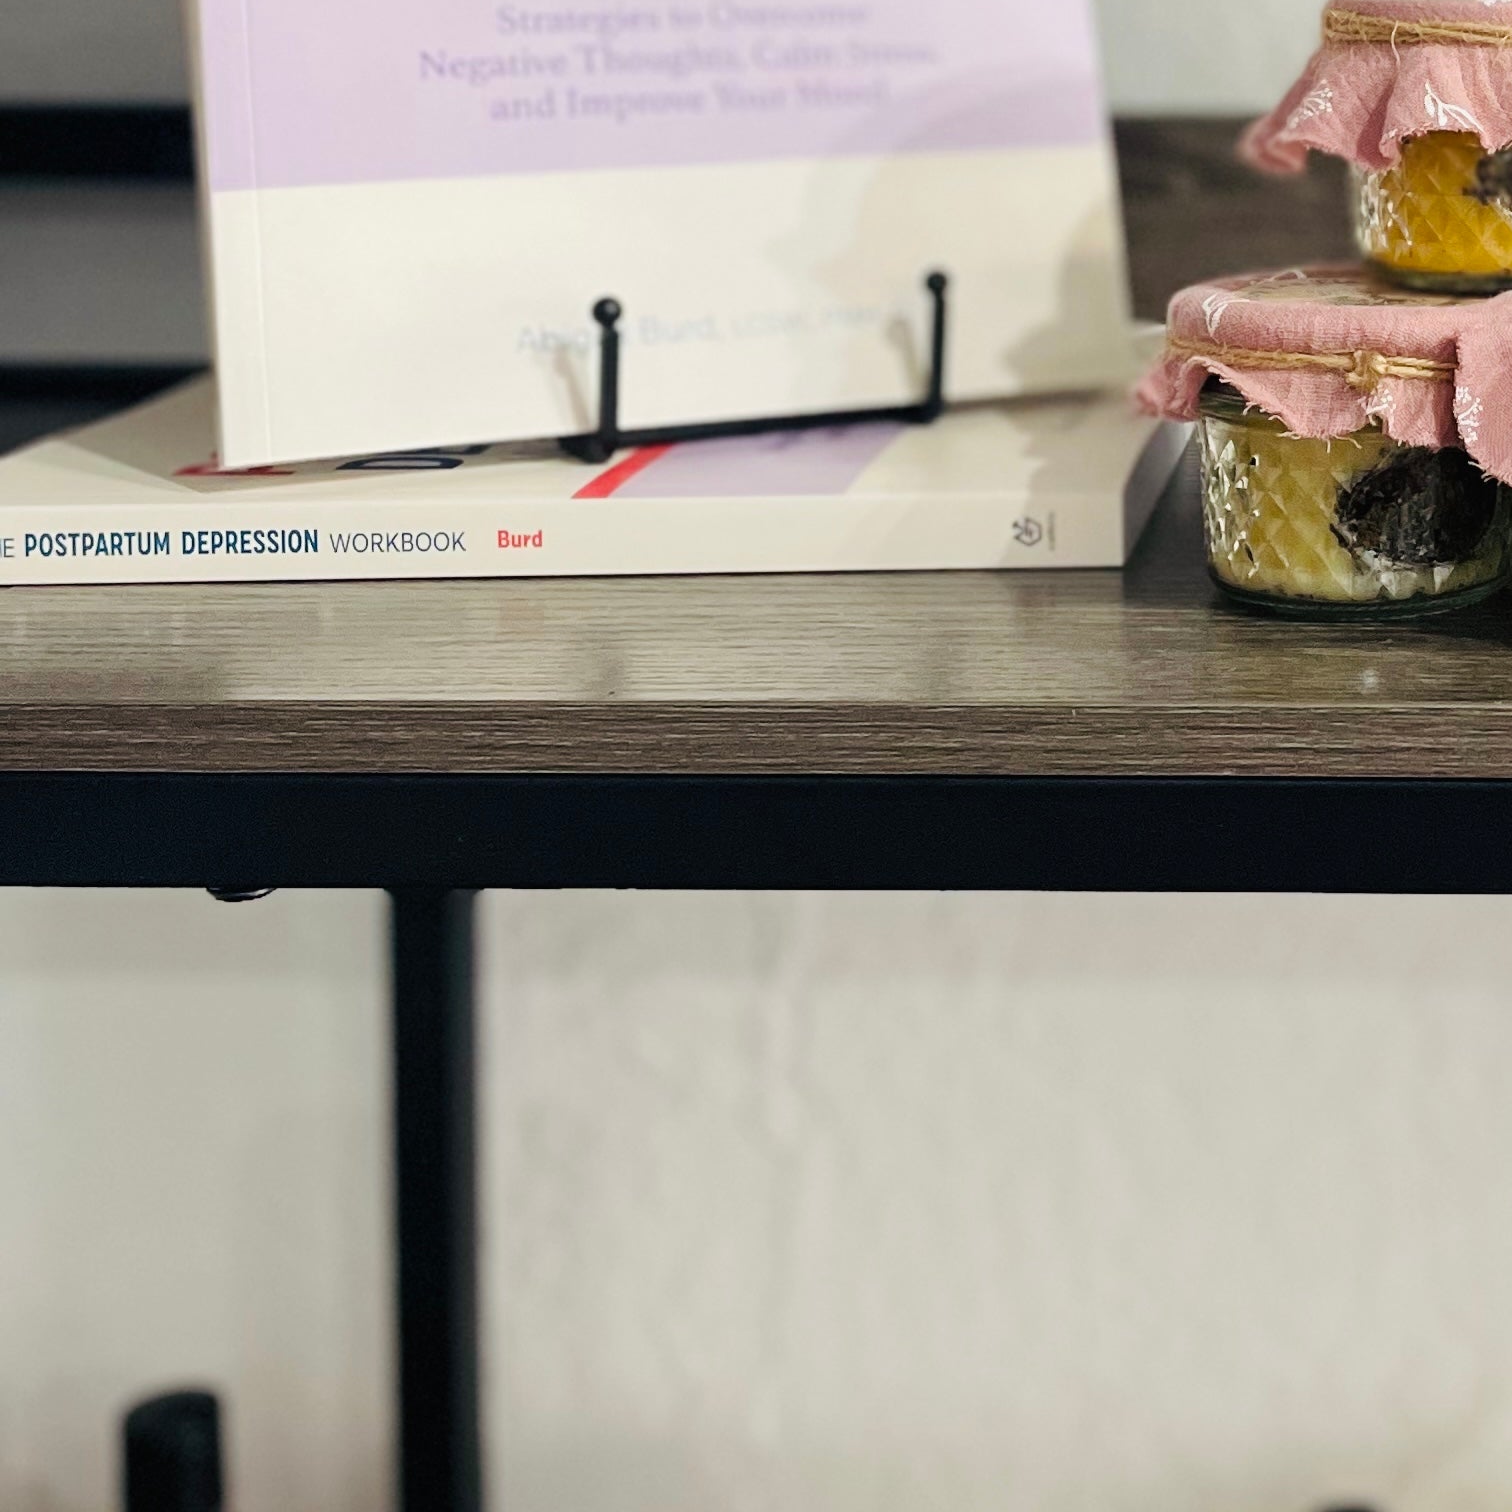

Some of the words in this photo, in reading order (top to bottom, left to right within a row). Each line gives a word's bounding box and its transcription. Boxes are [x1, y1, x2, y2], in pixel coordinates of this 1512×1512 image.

[496, 2, 661, 37] Strategies
[418, 48, 567, 84] Negative
[489, 87, 556, 121] and
[567, 86, 706, 123] Improve
[25, 531, 171, 557] POSTPARTUM
[182, 529, 319, 555] DEPRESSION
[329, 531, 466, 553] WORKBOOK
[497, 530, 543, 548] Burd
